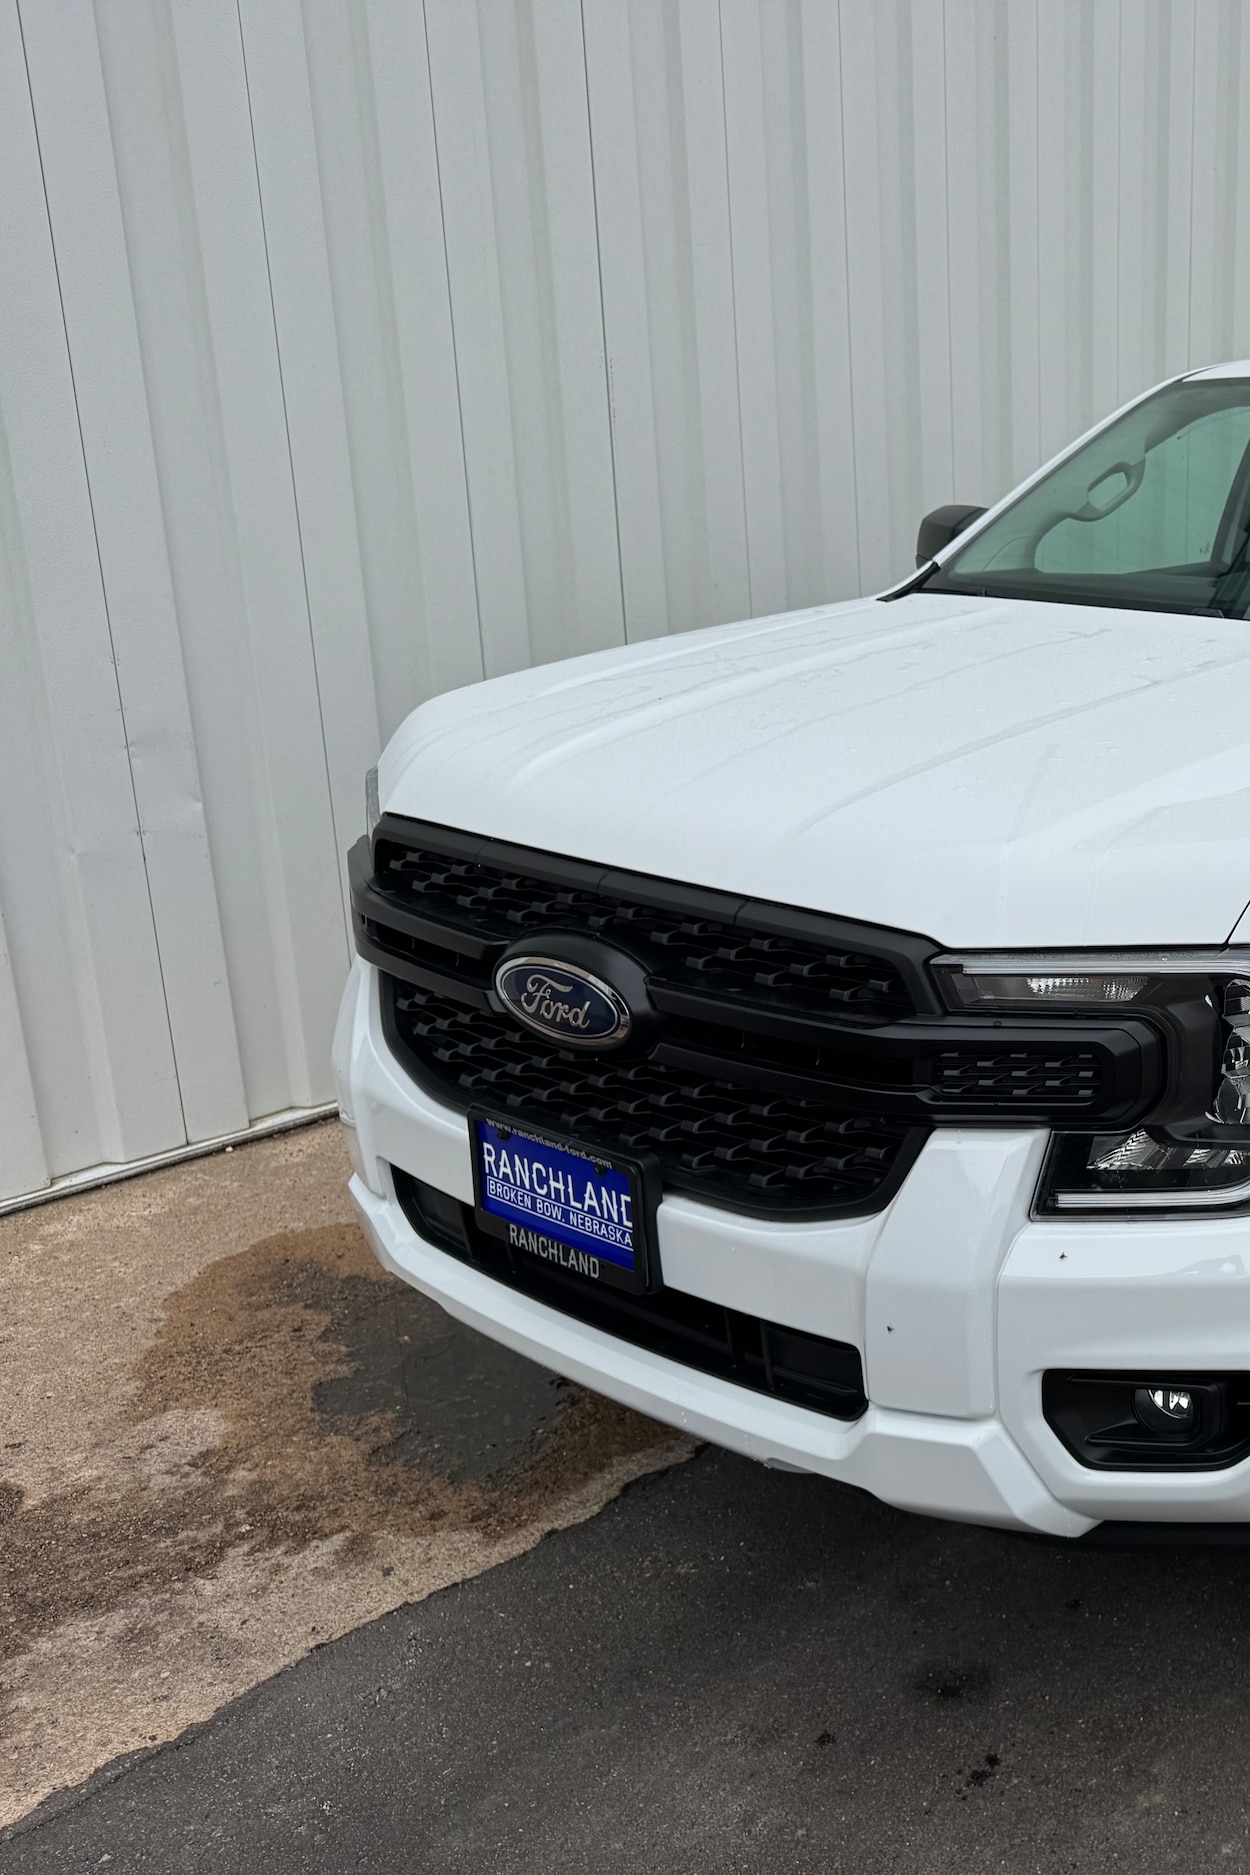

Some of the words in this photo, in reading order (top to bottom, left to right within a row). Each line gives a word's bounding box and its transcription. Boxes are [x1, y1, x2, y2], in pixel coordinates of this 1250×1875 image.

[520, 973, 591, 1029] Ford
[489, 1180, 532, 1210] BROKEN
[569, 1211, 633, 1247] NEBRASKA
[509, 1223, 600, 1279] RANCHLAND
